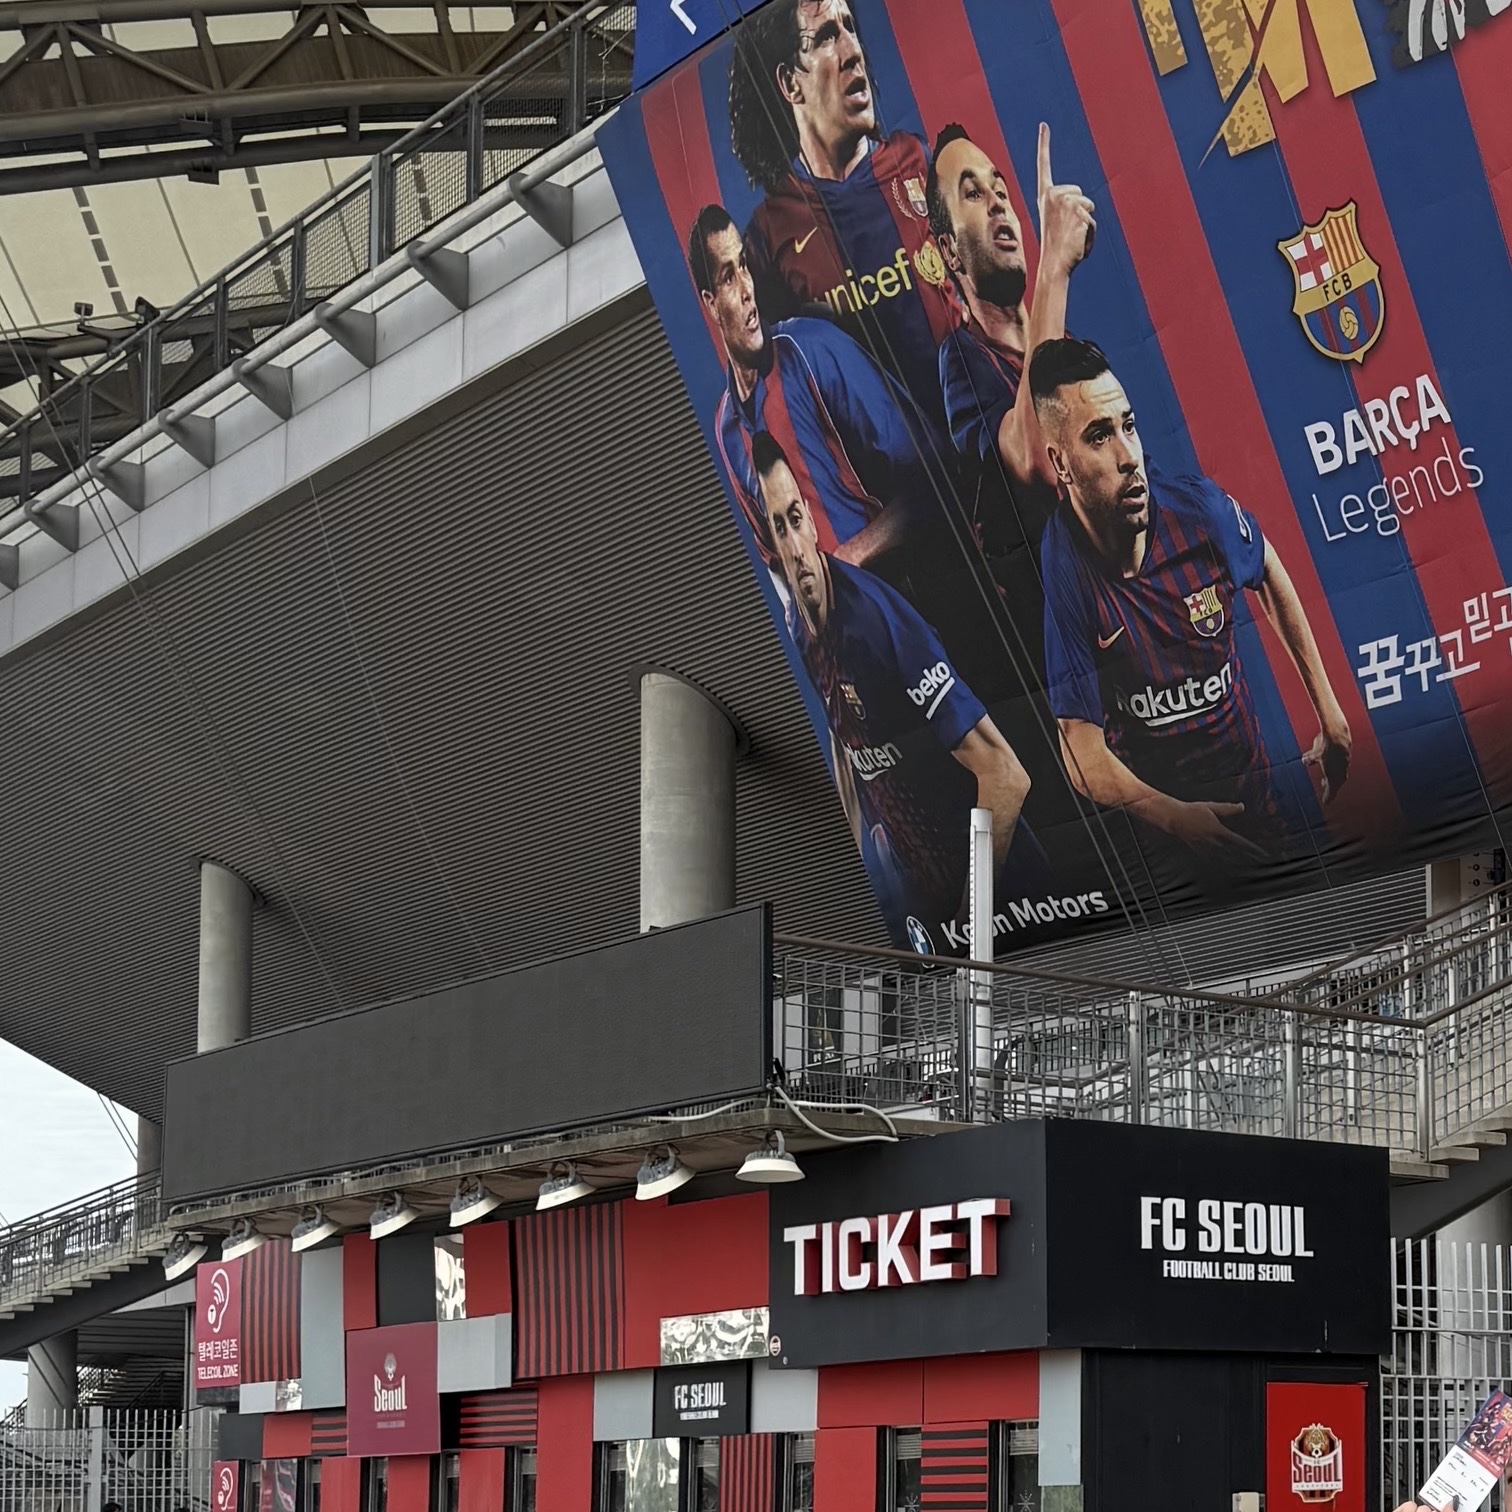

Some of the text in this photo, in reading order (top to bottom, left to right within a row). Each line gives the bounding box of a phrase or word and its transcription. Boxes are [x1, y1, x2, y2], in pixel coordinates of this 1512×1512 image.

[1321, 273, 1354, 302] FCB
[1303, 373, 1453, 476] BARÇA
[1312, 436, 1485, 542] Legends
[906, 661, 951, 706] beko
[1357, 629, 1481, 710] 꿈꾸고
[1128, 662, 1232, 719] akuten
[1008, 890, 1109, 928] Motors
[1140, 1196, 1314, 1257] FC SEOUL
[783, 1198, 1010, 1297] TICKET
[1163, 1259, 1295, 1283] FOOTBALL CLUB SEOUL
[197, 1364, 239, 1380] TELECOIL ZONE
[374, 1374, 407, 1412] Seoul
[674, 1381, 727, 1410] FC SEOUL
[1292, 1450, 1342, 1483] Seoul
